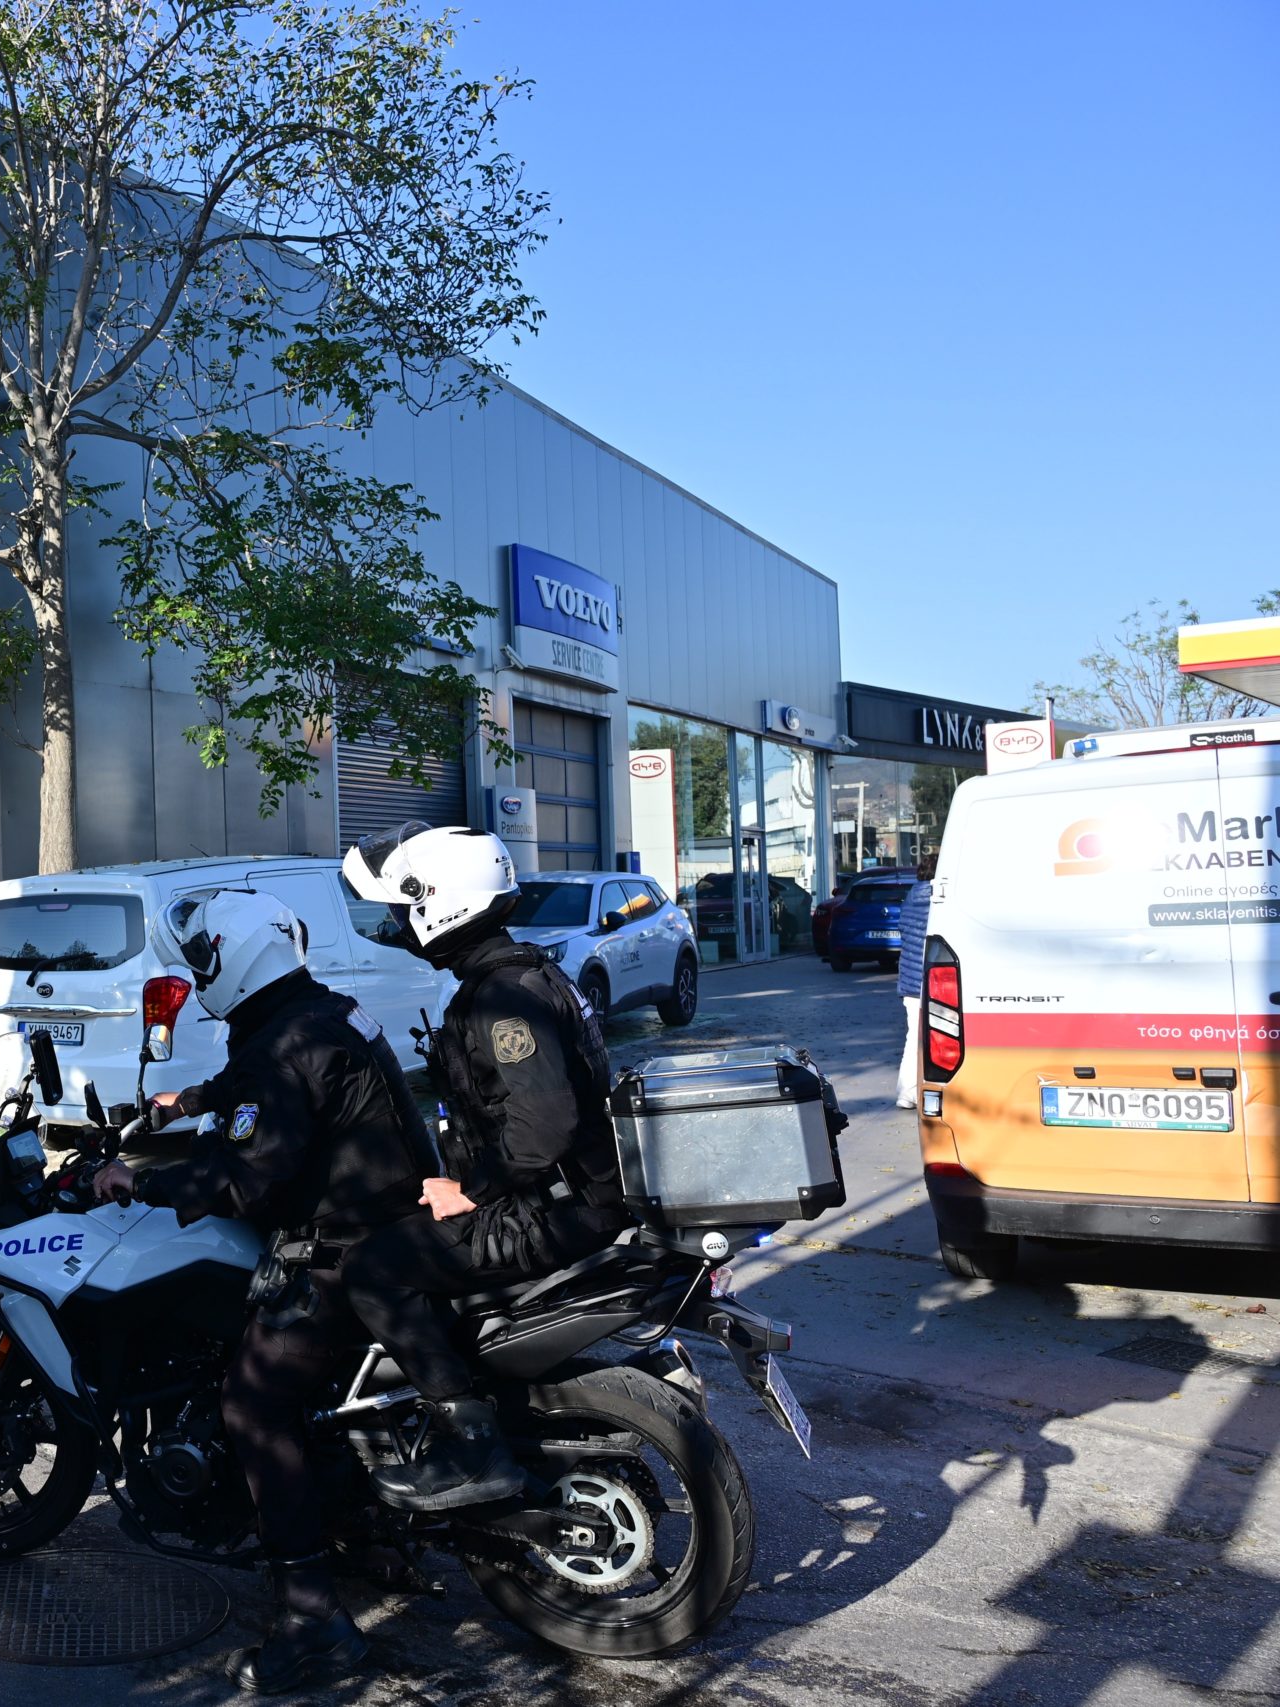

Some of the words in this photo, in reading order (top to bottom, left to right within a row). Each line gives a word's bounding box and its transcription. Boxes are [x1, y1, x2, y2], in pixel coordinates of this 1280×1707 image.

[534, 574, 611, 632] VOLVO
[552, 639, 582, 672] SERVICE
[583, 647, 605, 680] CENTRE
[922, 706, 973, 750] LYNK
[1000, 735, 1037, 747] BYD
[1214, 732, 1254, 744] Stathis
[1163, 805, 1280, 843] Mar
[1163, 885, 1214, 898] Online
[976, 995, 1065, 1003] TRANSIT
[1136, 1024, 1182, 1038] τόσο
[1189, 1024, 1249, 1041] φθηνά
[1044, 1106, 1057, 1114] GR
[706, 1241, 726, 1250] GIVI
